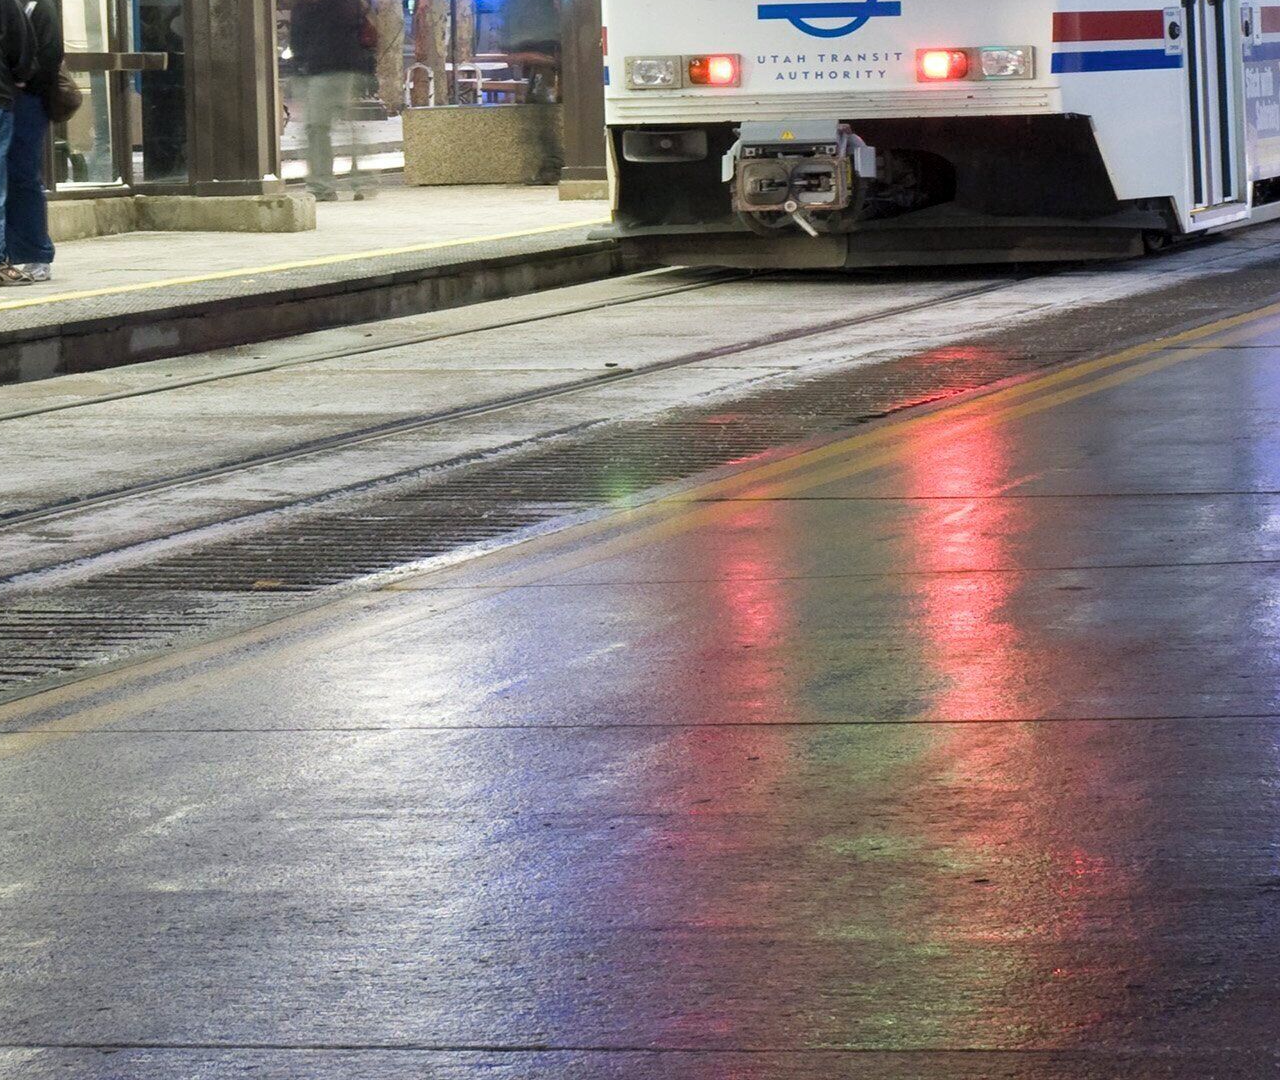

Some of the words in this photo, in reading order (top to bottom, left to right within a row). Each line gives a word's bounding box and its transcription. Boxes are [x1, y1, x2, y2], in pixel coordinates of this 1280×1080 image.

[757, 54, 806, 64] UTAH
[818, 52, 903, 63] TRANSIT
[775, 70, 887, 81] AUTHORITY
